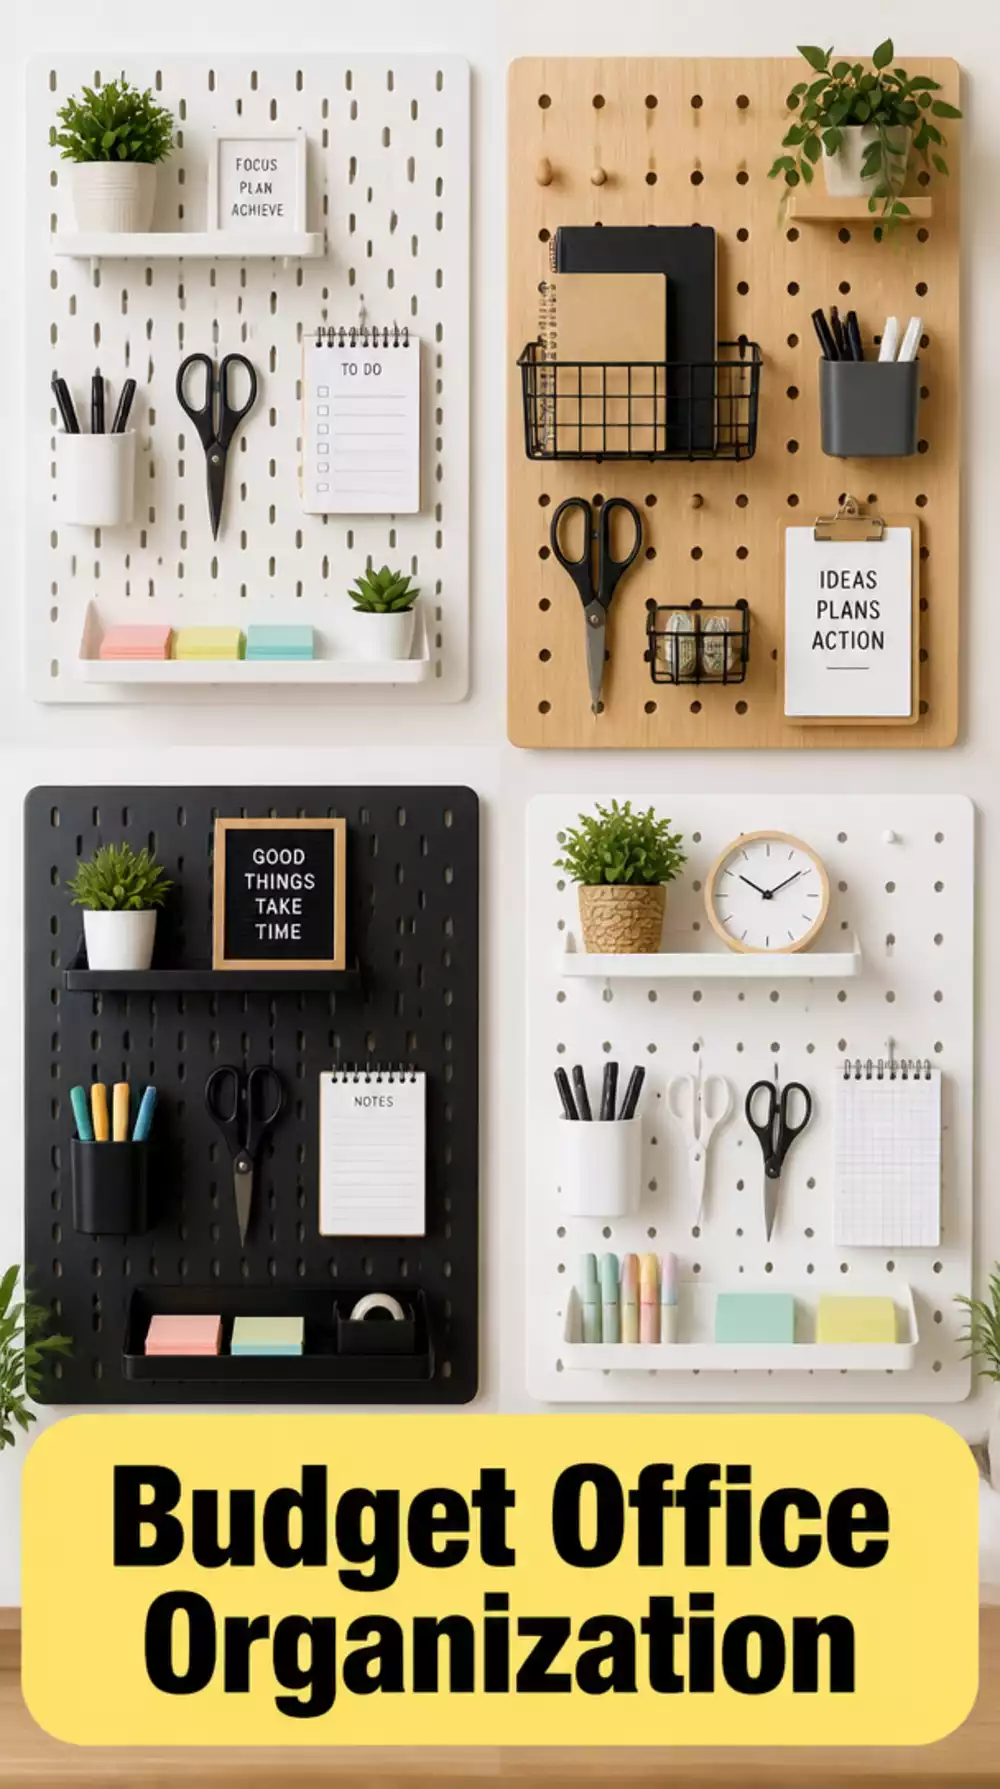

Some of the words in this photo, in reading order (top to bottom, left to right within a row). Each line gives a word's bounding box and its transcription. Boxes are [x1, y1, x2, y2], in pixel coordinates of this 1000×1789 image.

[236, 157, 278, 172] FOCUS
[239, 180, 273, 195] PLAN
[231, 203, 284, 217] ACHIEVE
[341, 362, 358, 376] TO
[364, 362, 382, 376] DO
[820, 570, 878, 590] IDEAS
[817, 599, 881, 620] PLANS
[811, 630, 885, 651] ACTION
[252, 848, 306, 866] GOOD
[244, 872, 315, 891] THINGS
[255, 897, 302, 915] TAKE
[255, 923, 302, 940] TIME
[354, 1095, 394, 1108] NOTES
